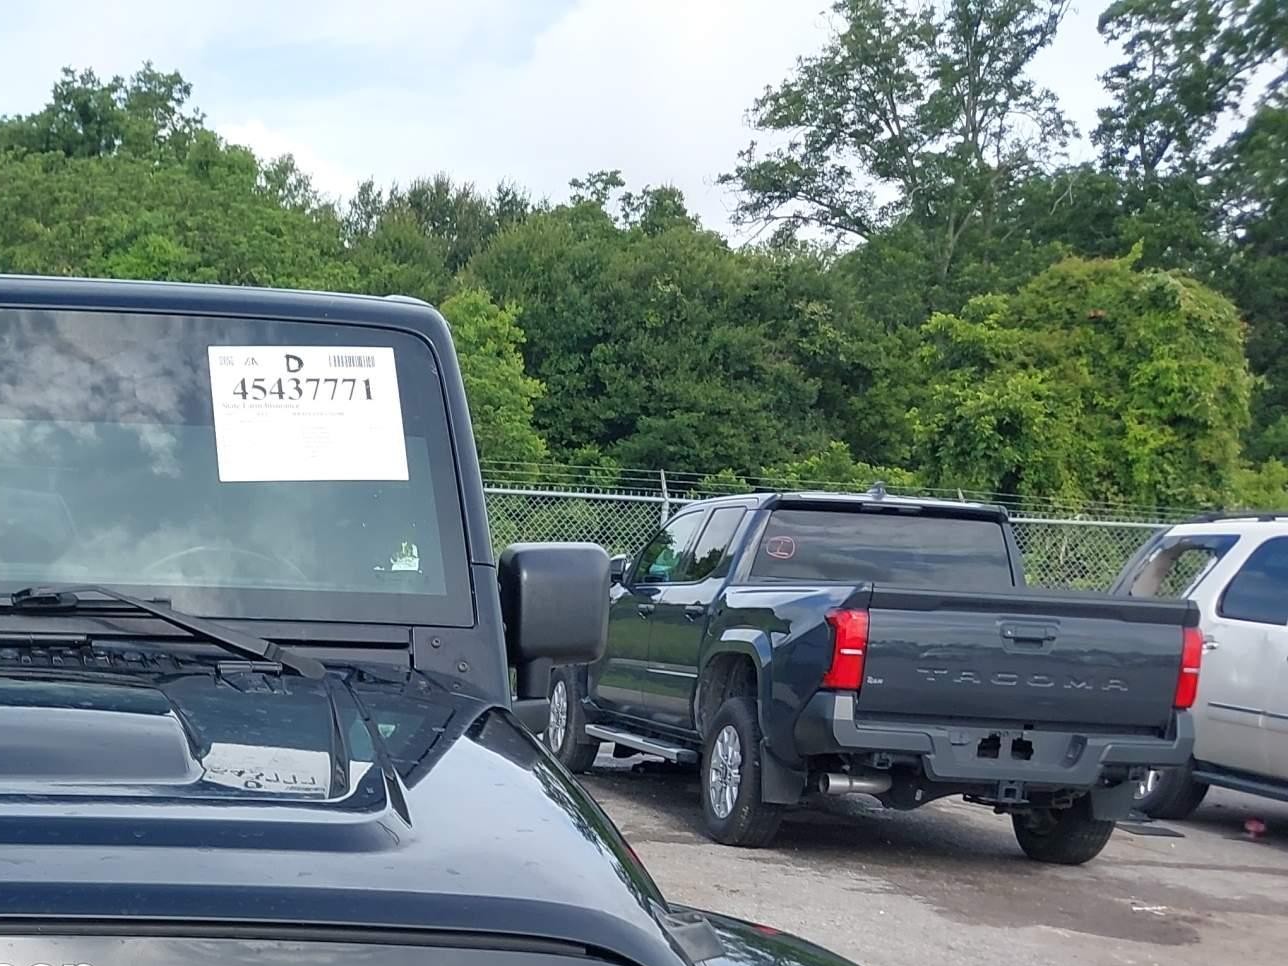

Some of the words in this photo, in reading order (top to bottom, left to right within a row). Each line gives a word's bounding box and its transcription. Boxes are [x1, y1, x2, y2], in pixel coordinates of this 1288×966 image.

[284, 353, 304, 373] D
[232, 377, 373, 401] 45437771
[916, 669, 1129, 692] TACOMA
